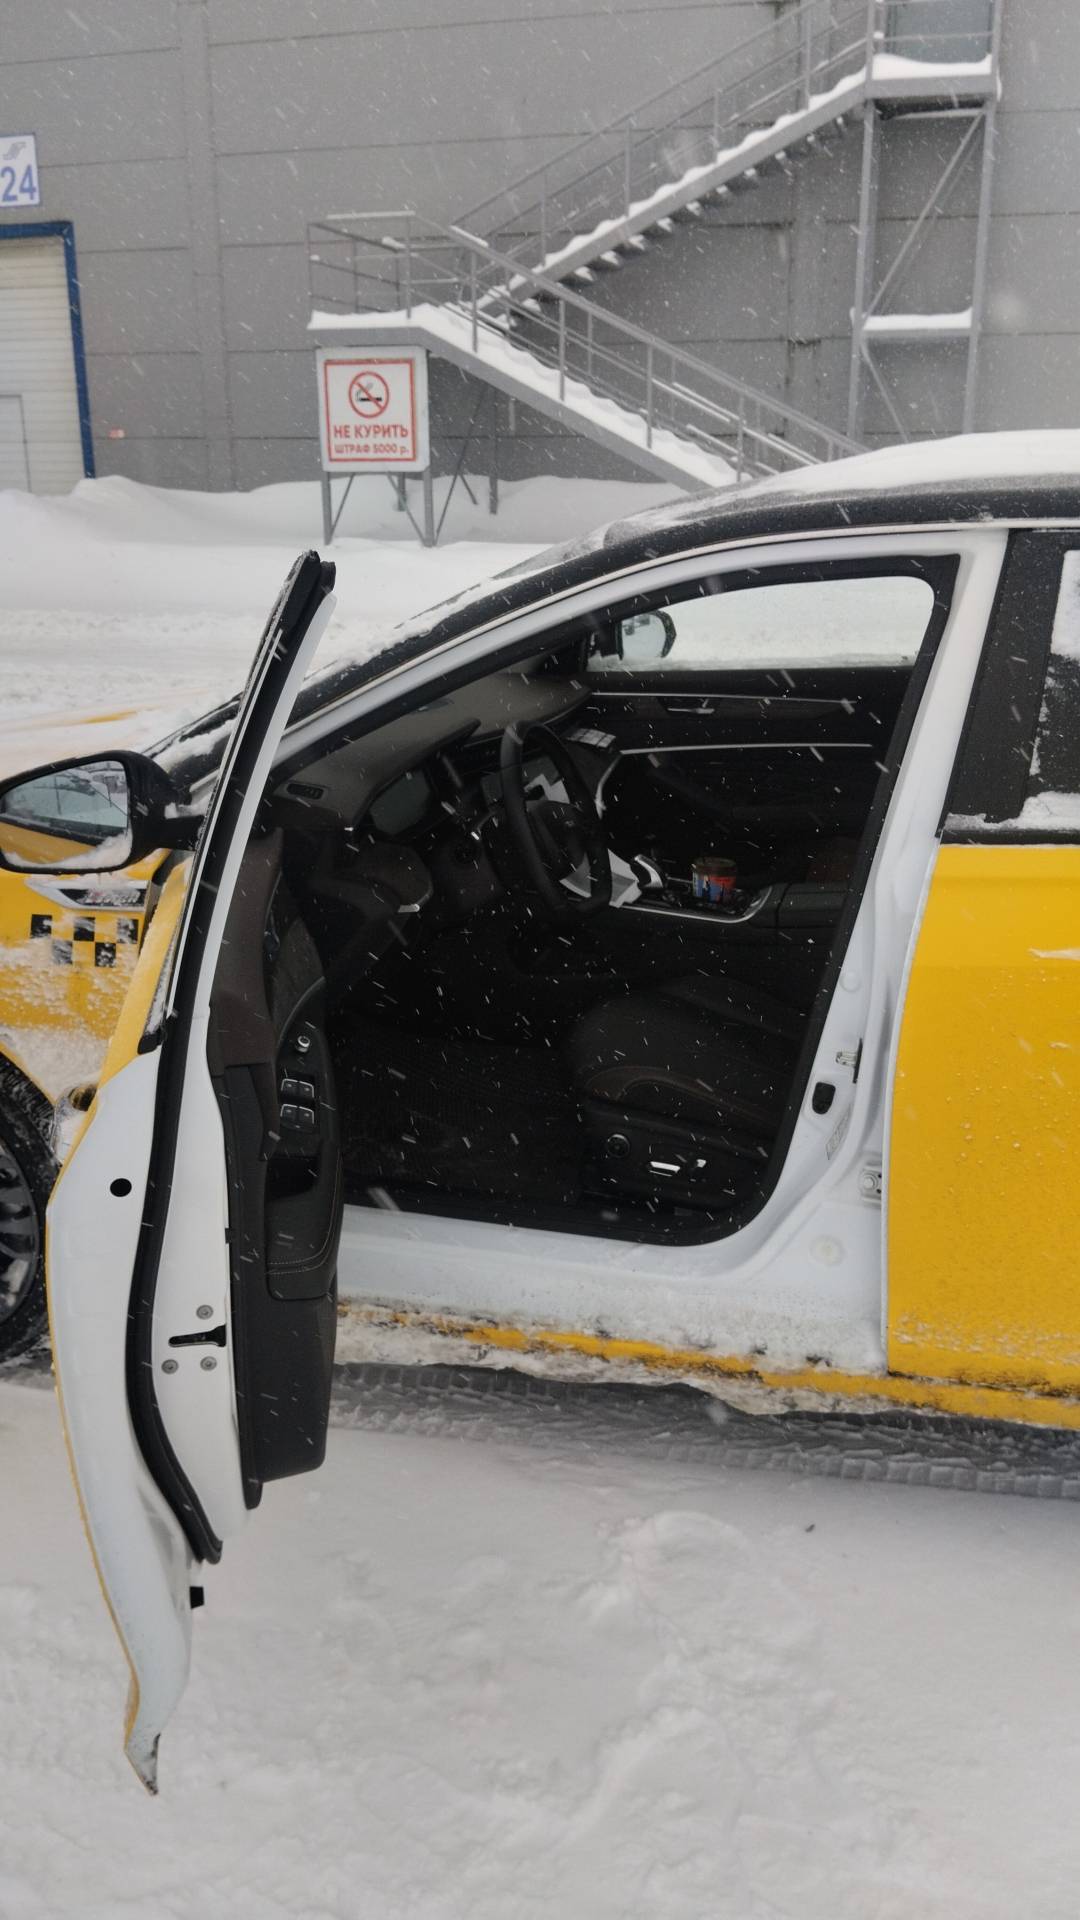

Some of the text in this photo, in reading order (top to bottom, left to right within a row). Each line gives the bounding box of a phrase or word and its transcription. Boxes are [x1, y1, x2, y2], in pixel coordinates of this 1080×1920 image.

[0, 164, 37, 202] 24
[333, 424, 409, 438] НЕ КУРИТЬ
[335, 443, 370, 454] ШТРАФ
[373, 443, 398, 454] 5000
